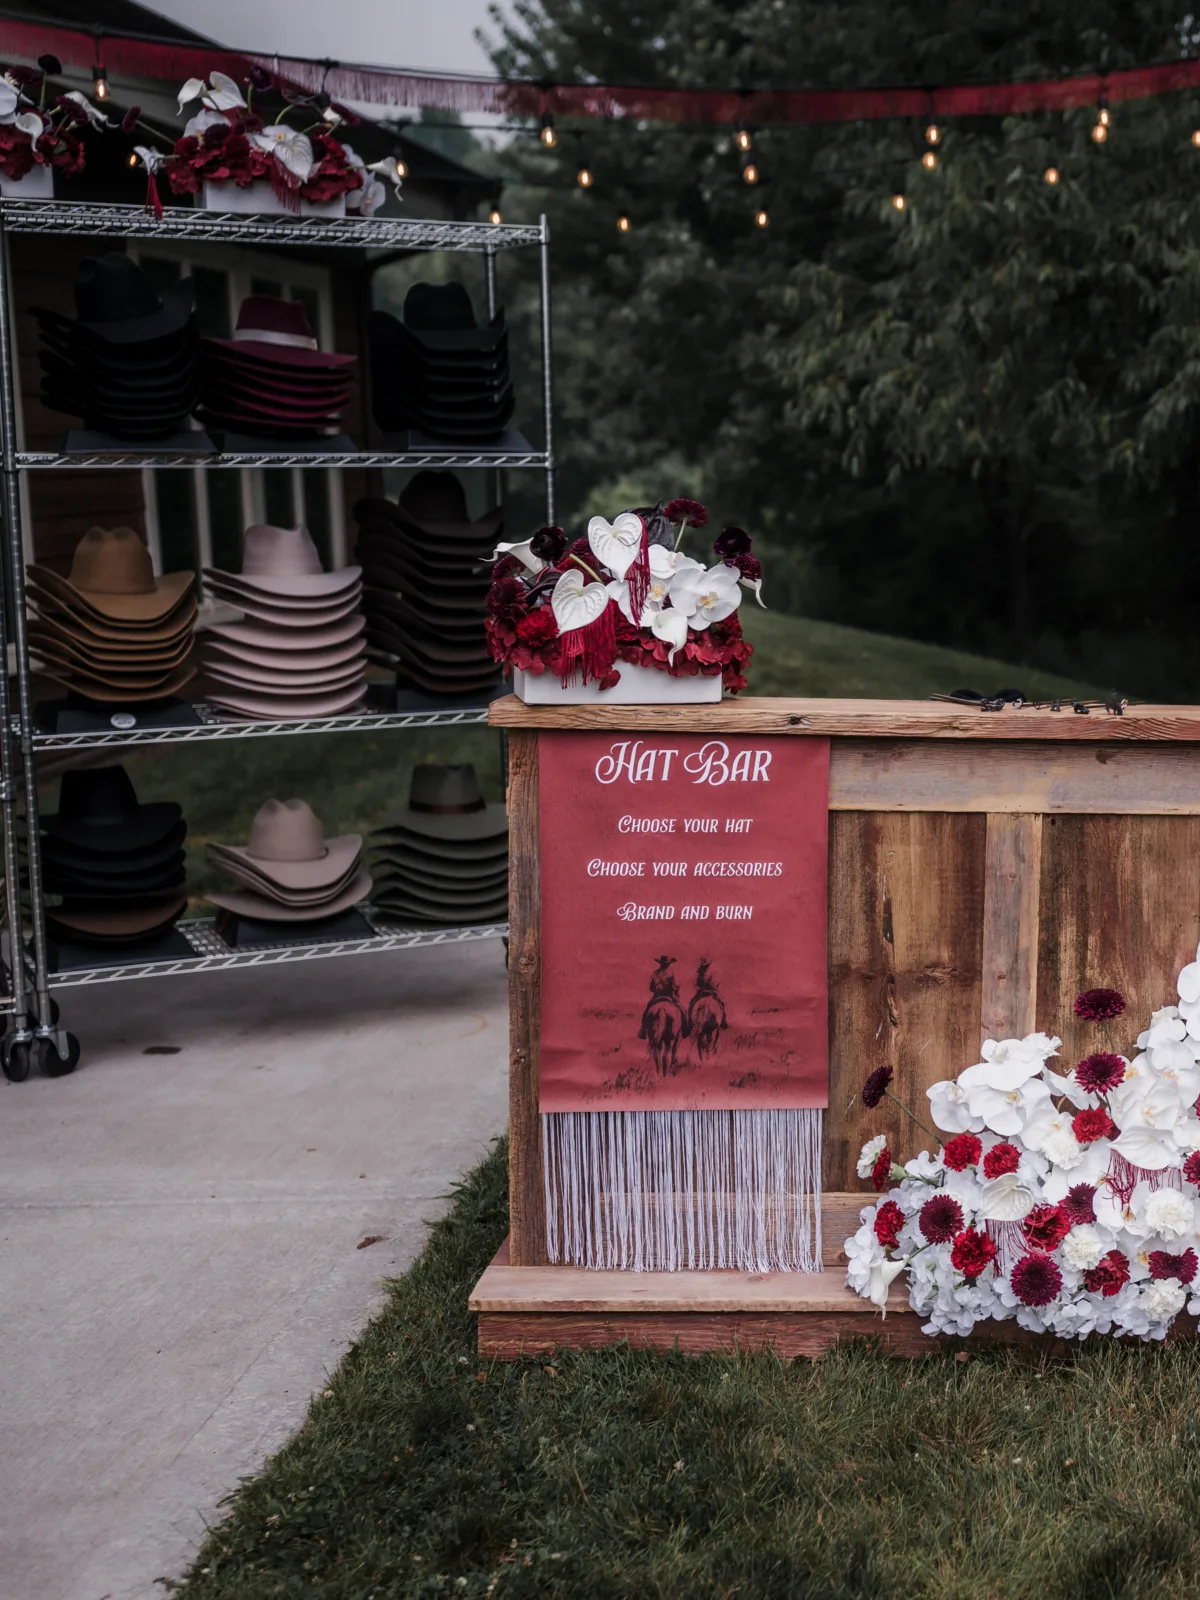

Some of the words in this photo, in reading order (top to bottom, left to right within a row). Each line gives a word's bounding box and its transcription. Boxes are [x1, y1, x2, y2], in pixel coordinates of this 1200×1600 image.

[594, 740, 679, 785] HAT
[683, 740, 773, 787] BAR
[617, 814, 678, 834] CHOOSE
[683, 818, 719, 833] YOUR
[724, 818, 754, 833] HAT
[586, 858, 646, 877] CHOOSE
[652, 861, 688, 877] YOUR
[693, 861, 783, 877] ACCESSORIES
[616, 901, 676, 922] BRAND
[680, 905, 710, 920] AND
[715, 905, 754, 920] BURN
